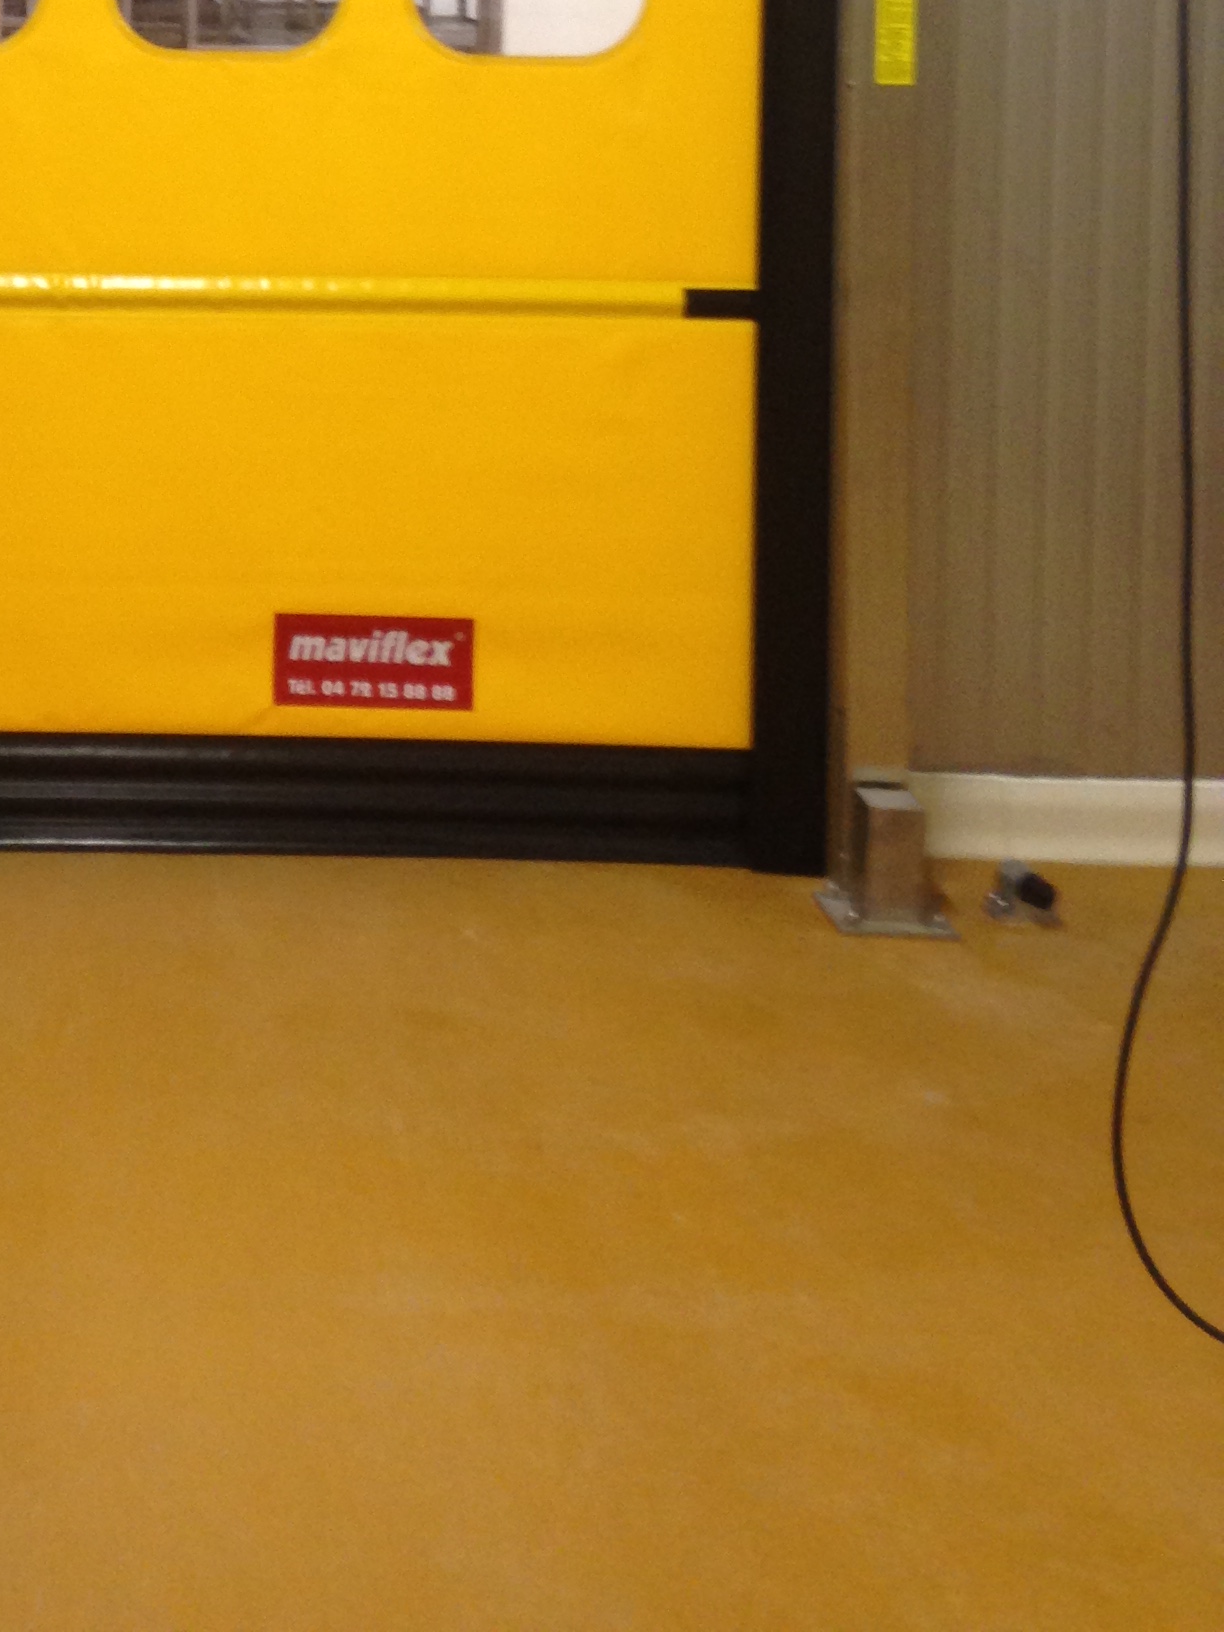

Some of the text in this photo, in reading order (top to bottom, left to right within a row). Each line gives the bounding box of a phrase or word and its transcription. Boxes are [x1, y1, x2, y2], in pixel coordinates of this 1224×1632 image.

[289, 630, 455, 667] maviflex
[321, 679, 345, 696] 04
[378, 682, 398, 699] 15
